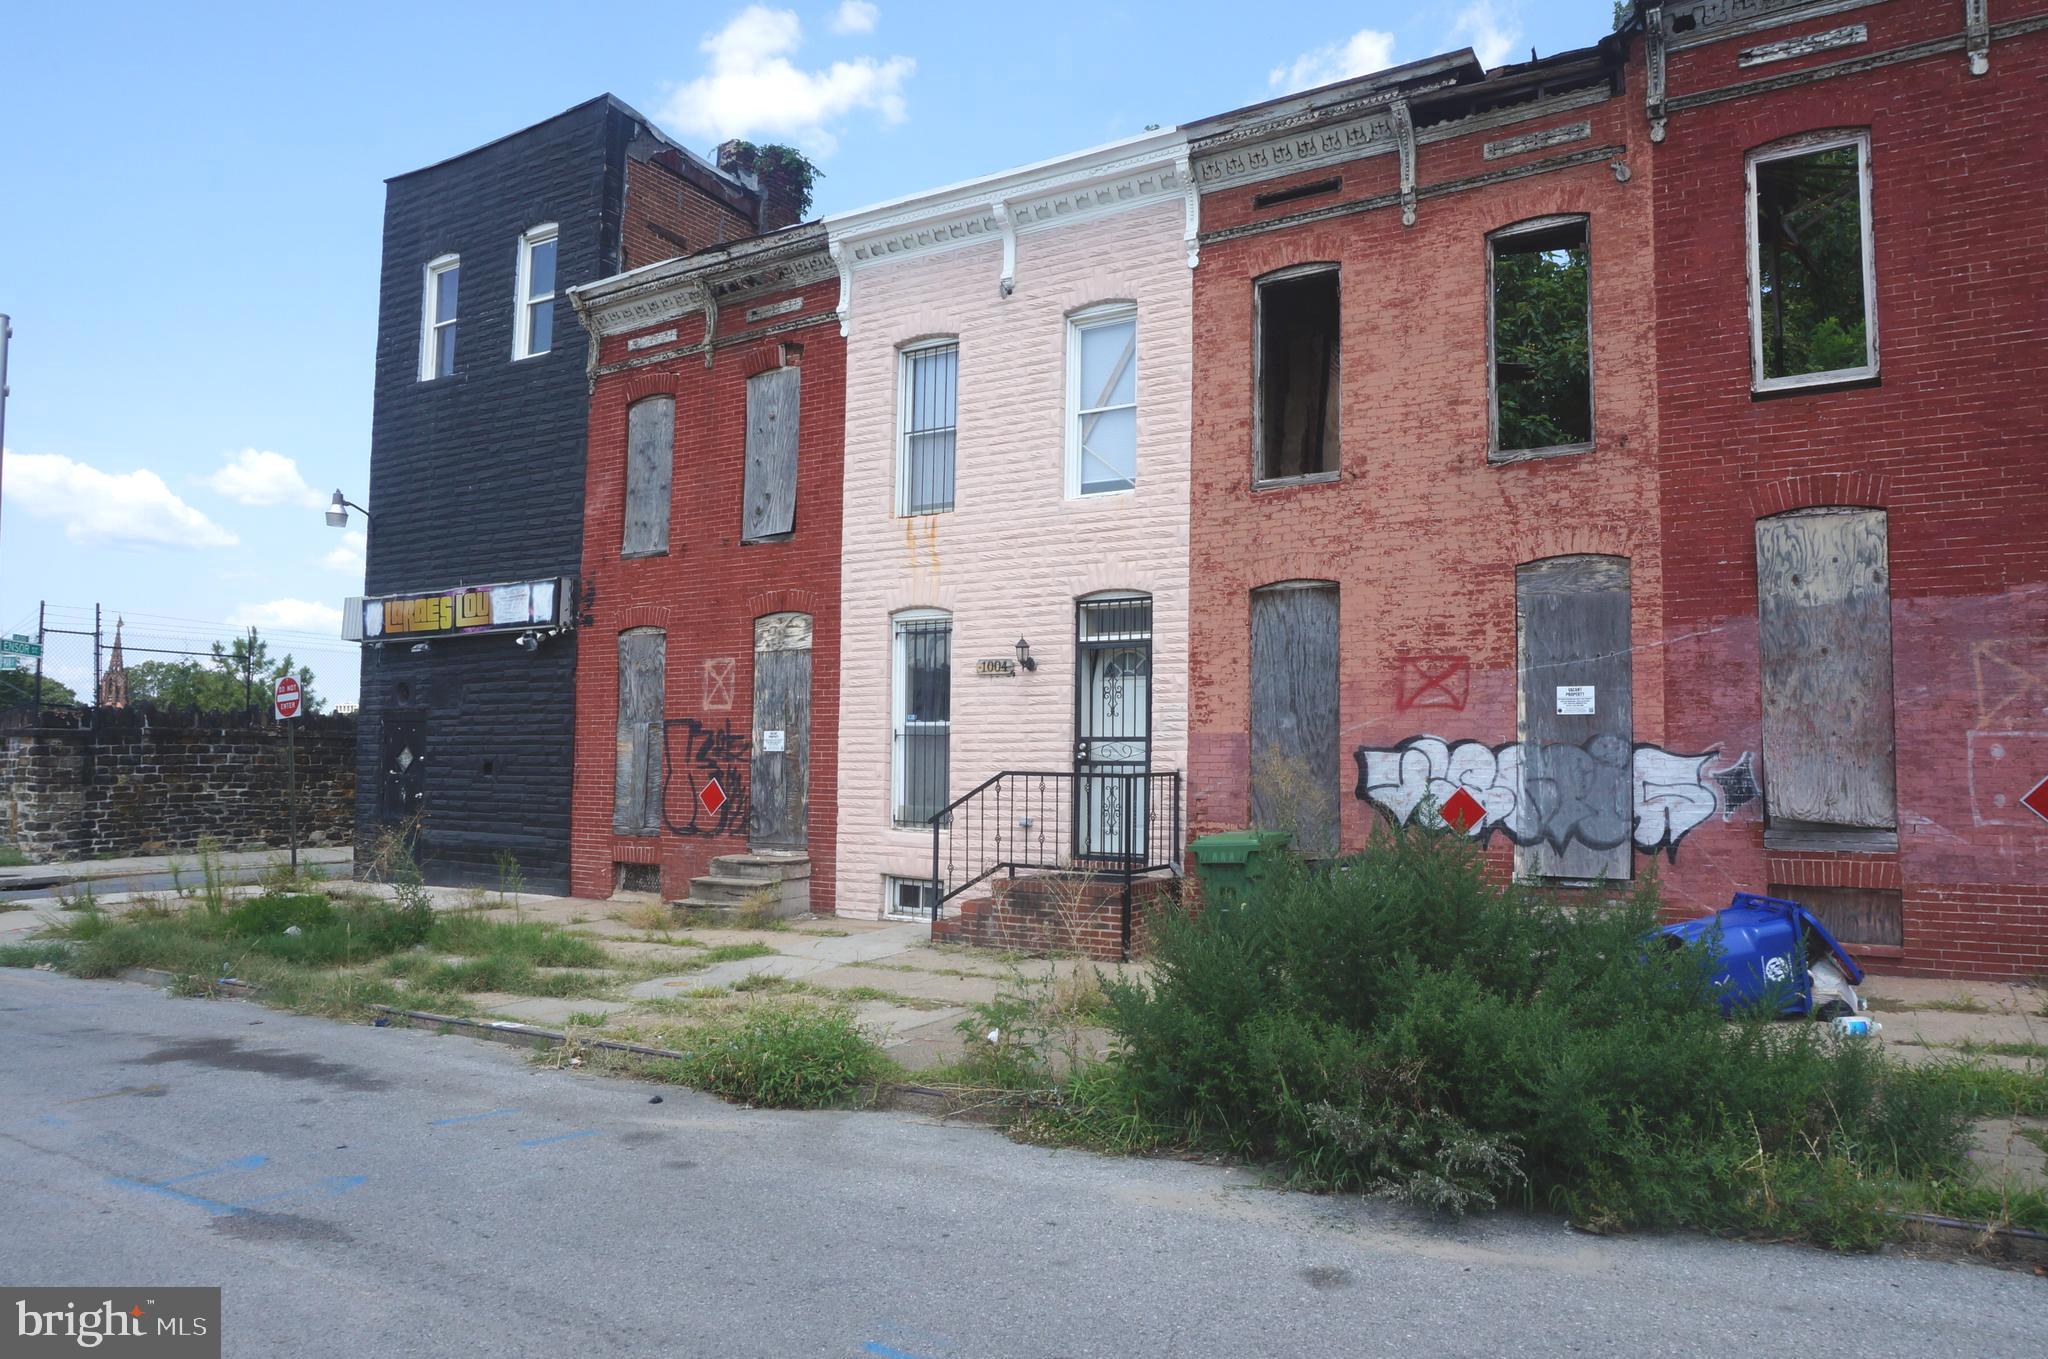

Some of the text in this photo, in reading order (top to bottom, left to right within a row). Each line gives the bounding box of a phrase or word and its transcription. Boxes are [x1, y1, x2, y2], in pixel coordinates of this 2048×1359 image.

[3, 641, 30, 653] ENSOR
[981, 660, 1008, 672] 1004
[287, 684, 297, 692] NOT
[280, 702, 296, 710] ENTER
